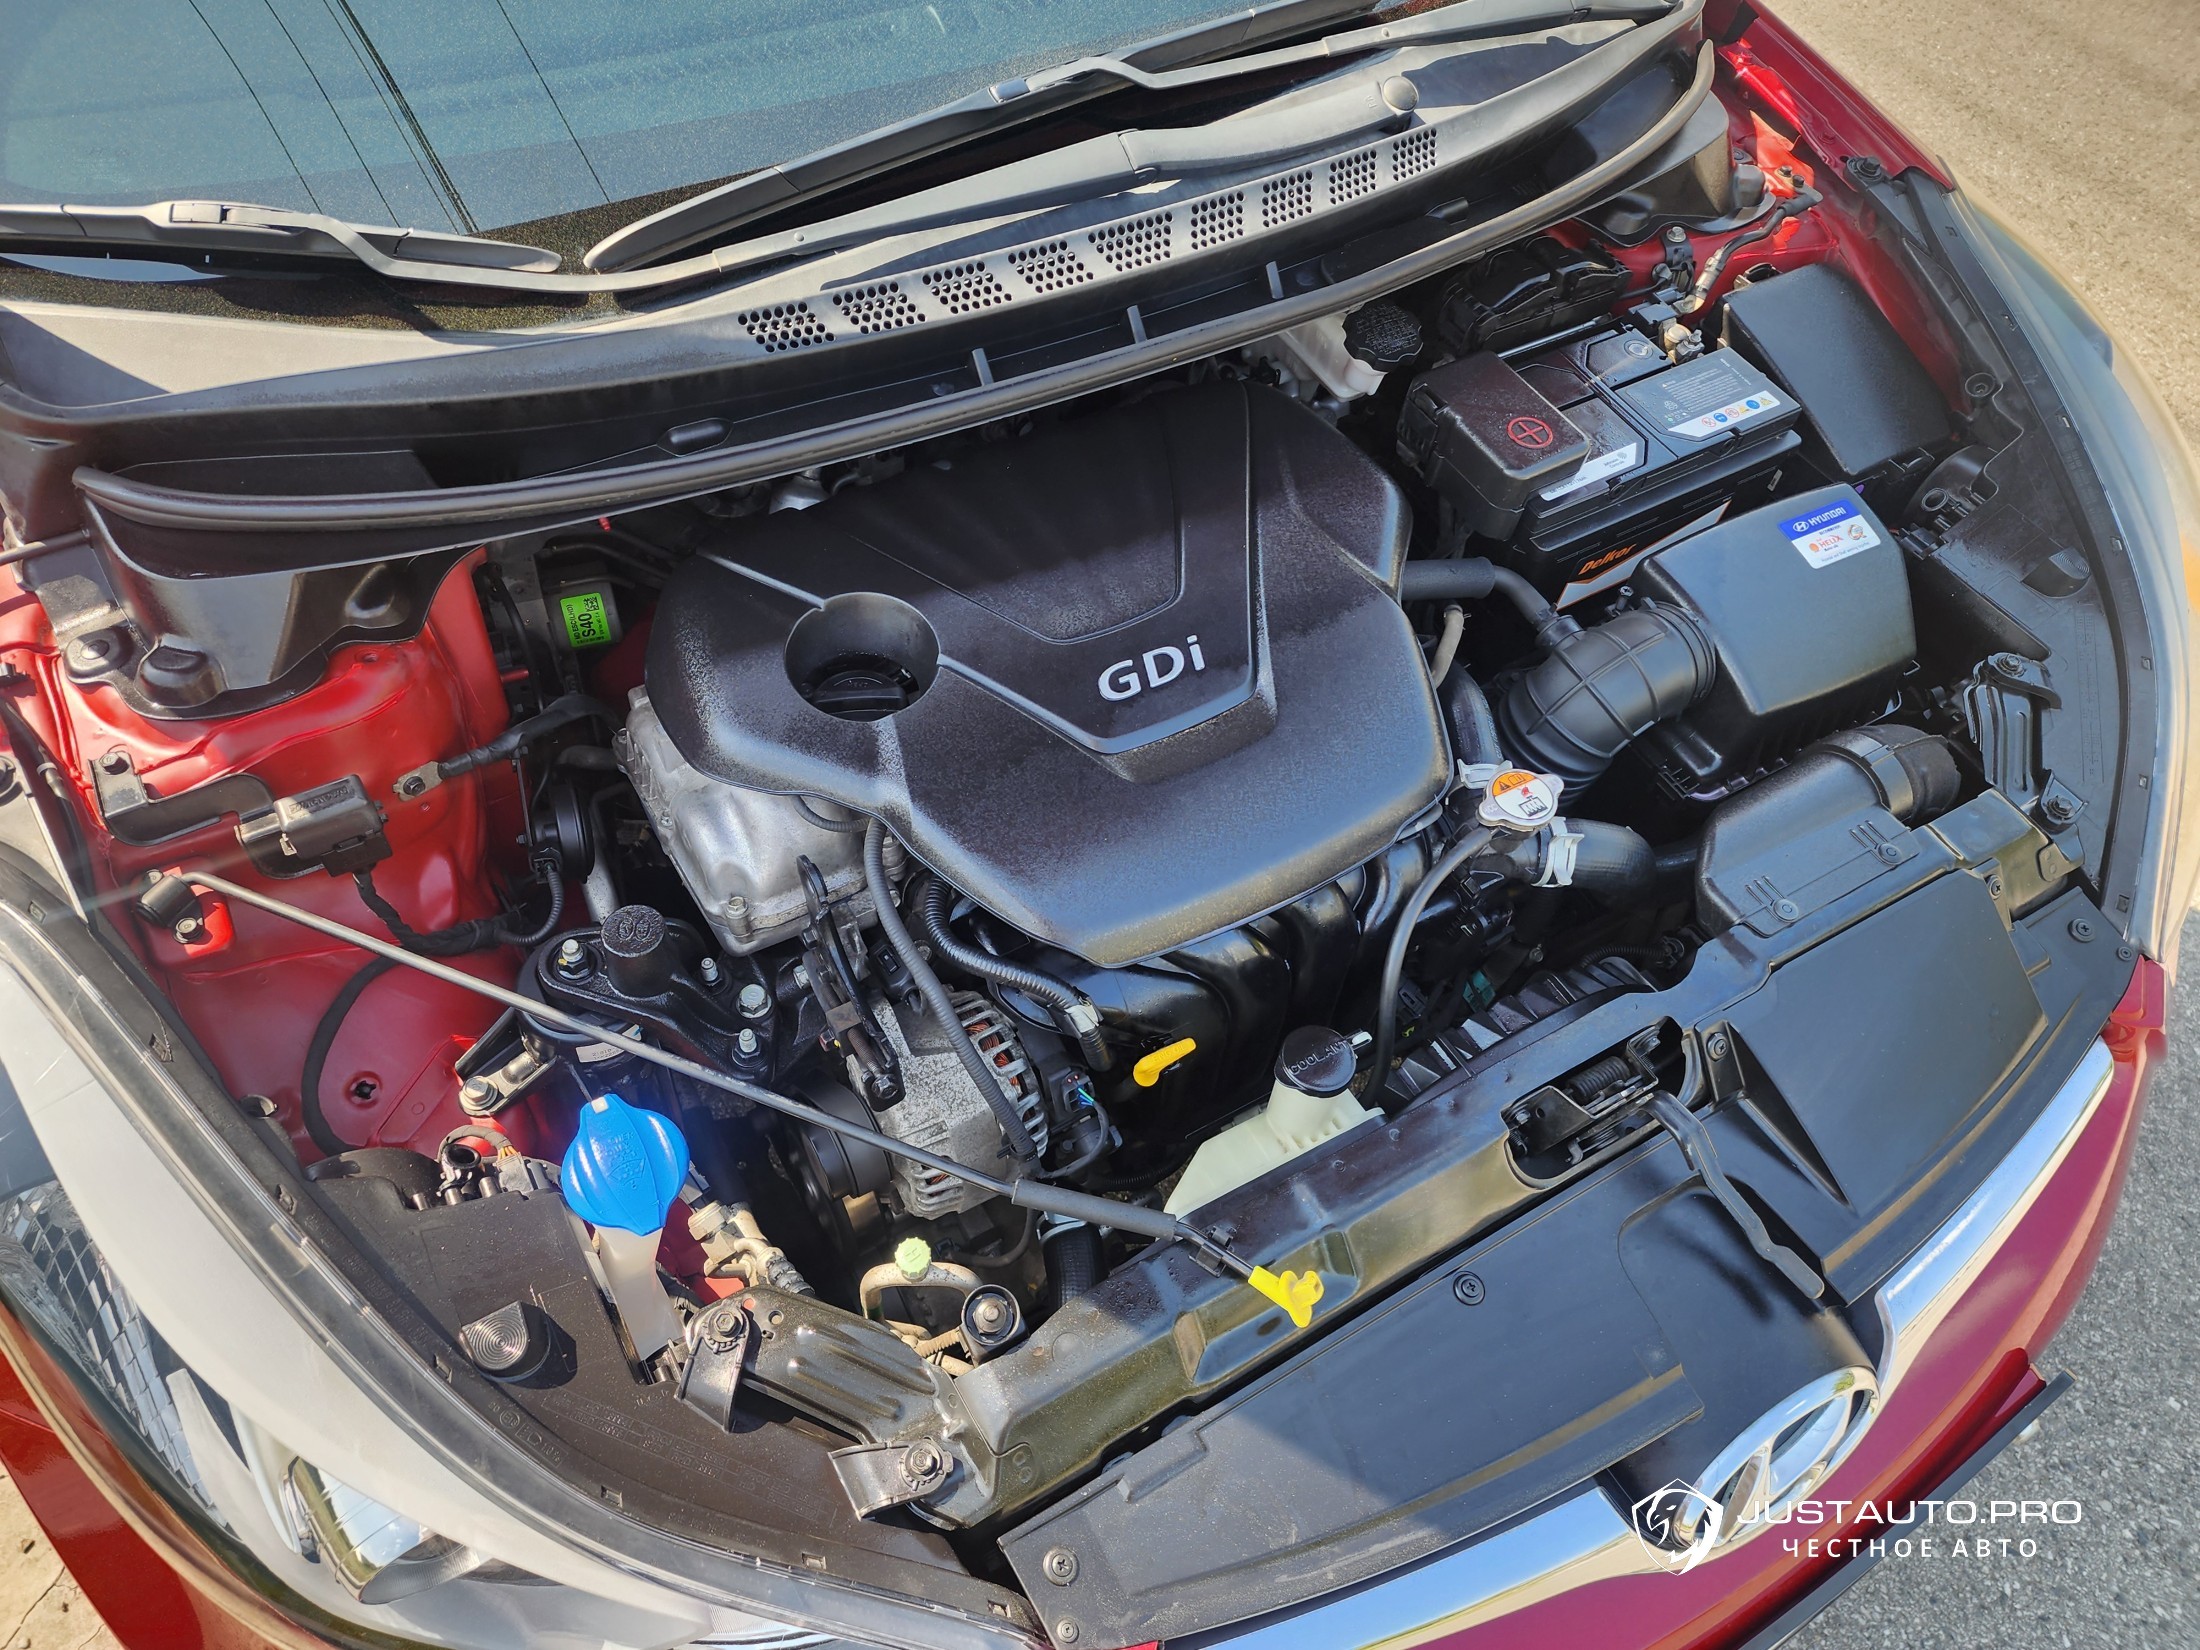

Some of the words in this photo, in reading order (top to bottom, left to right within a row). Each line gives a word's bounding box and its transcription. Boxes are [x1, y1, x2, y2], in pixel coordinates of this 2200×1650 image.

[1807, 506, 1847, 527] HYUNDAI
[1578, 543, 1637, 576] Delkor
[578, 613, 596, 637] S40
[1098, 634, 1205, 701] GDi
[1288, 1040, 1348, 1076] COOLANT
